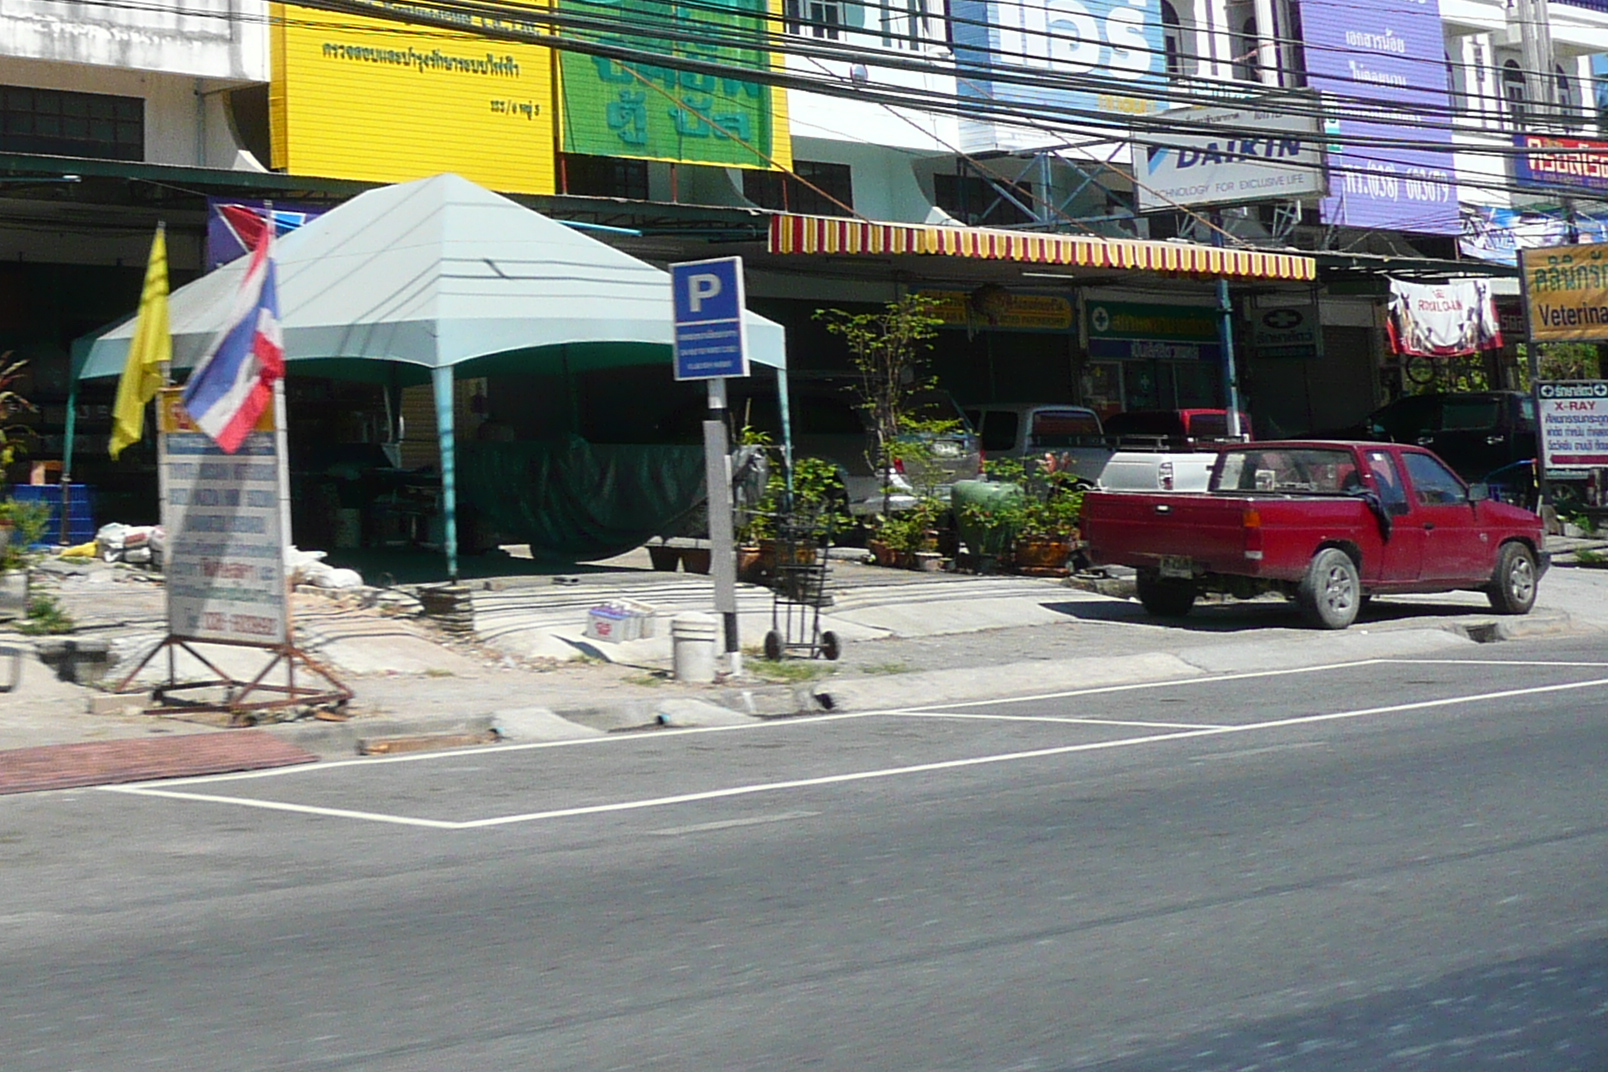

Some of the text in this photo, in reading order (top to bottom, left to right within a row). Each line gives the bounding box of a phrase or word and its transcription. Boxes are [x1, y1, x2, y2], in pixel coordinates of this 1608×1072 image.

[1345, 28, 1406, 53] เอกสารน้อย
[1176, 137, 1301, 169] DAIKIN
[1216, 181, 1235, 193] FOR
[1239, 176, 1285, 191] EXCLUSIVE
[1286, 173, 1304, 185] LIFE
[688, 273, 722, 312] P
[1554, 400, 1596, 411] X-RAY
